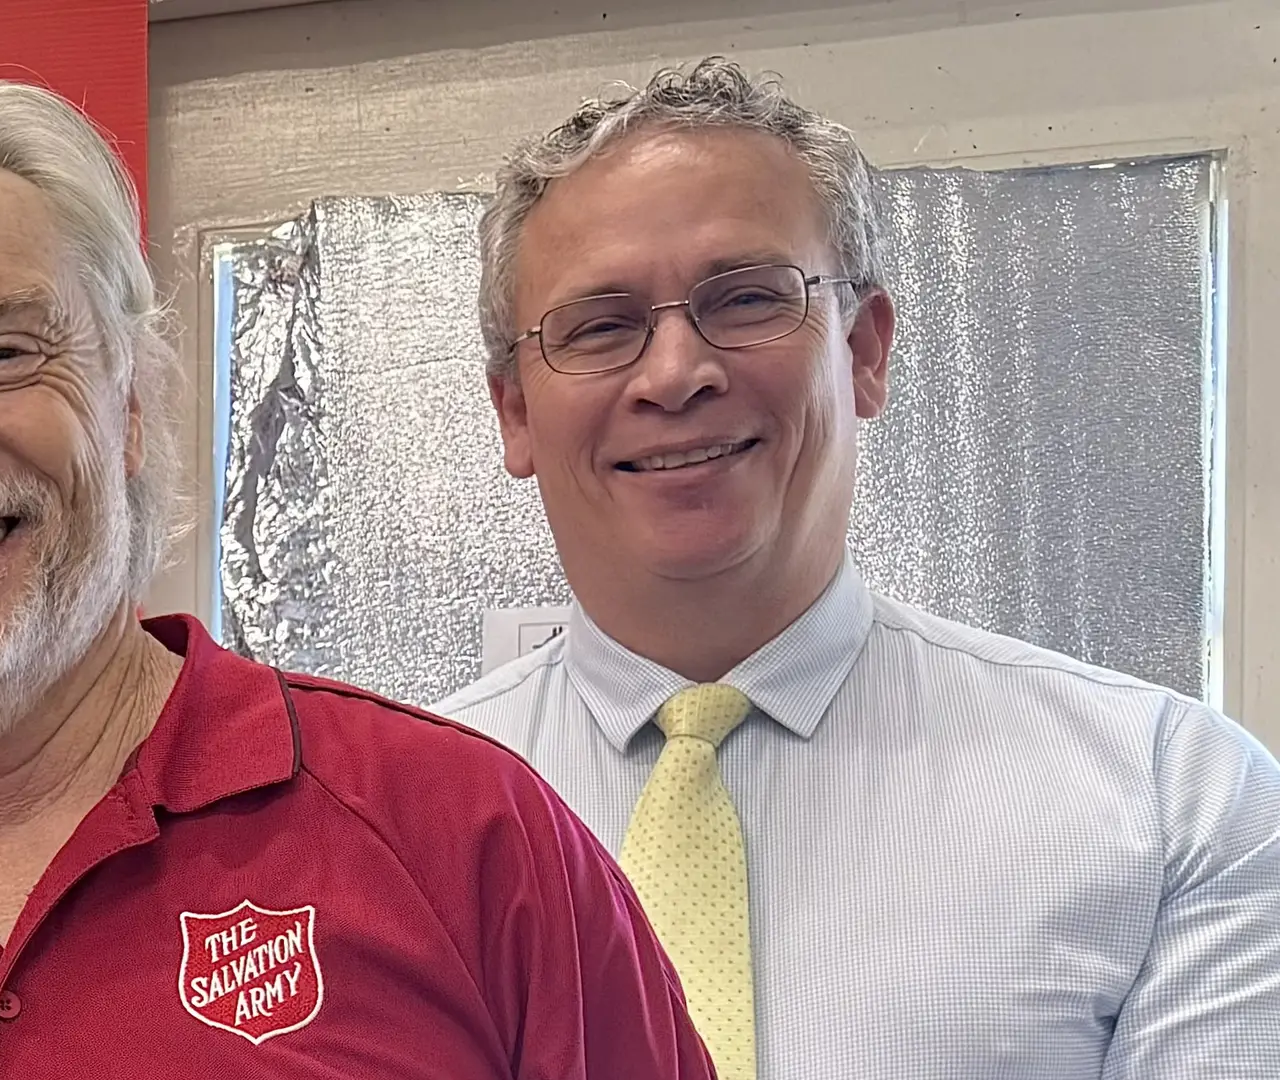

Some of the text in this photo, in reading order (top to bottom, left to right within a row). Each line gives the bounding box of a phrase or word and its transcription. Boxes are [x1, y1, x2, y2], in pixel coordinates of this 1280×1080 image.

[191, 921, 305, 1008] SALVATION
[205, 918, 257, 963] THE
[235, 961, 301, 1026] ARMY
